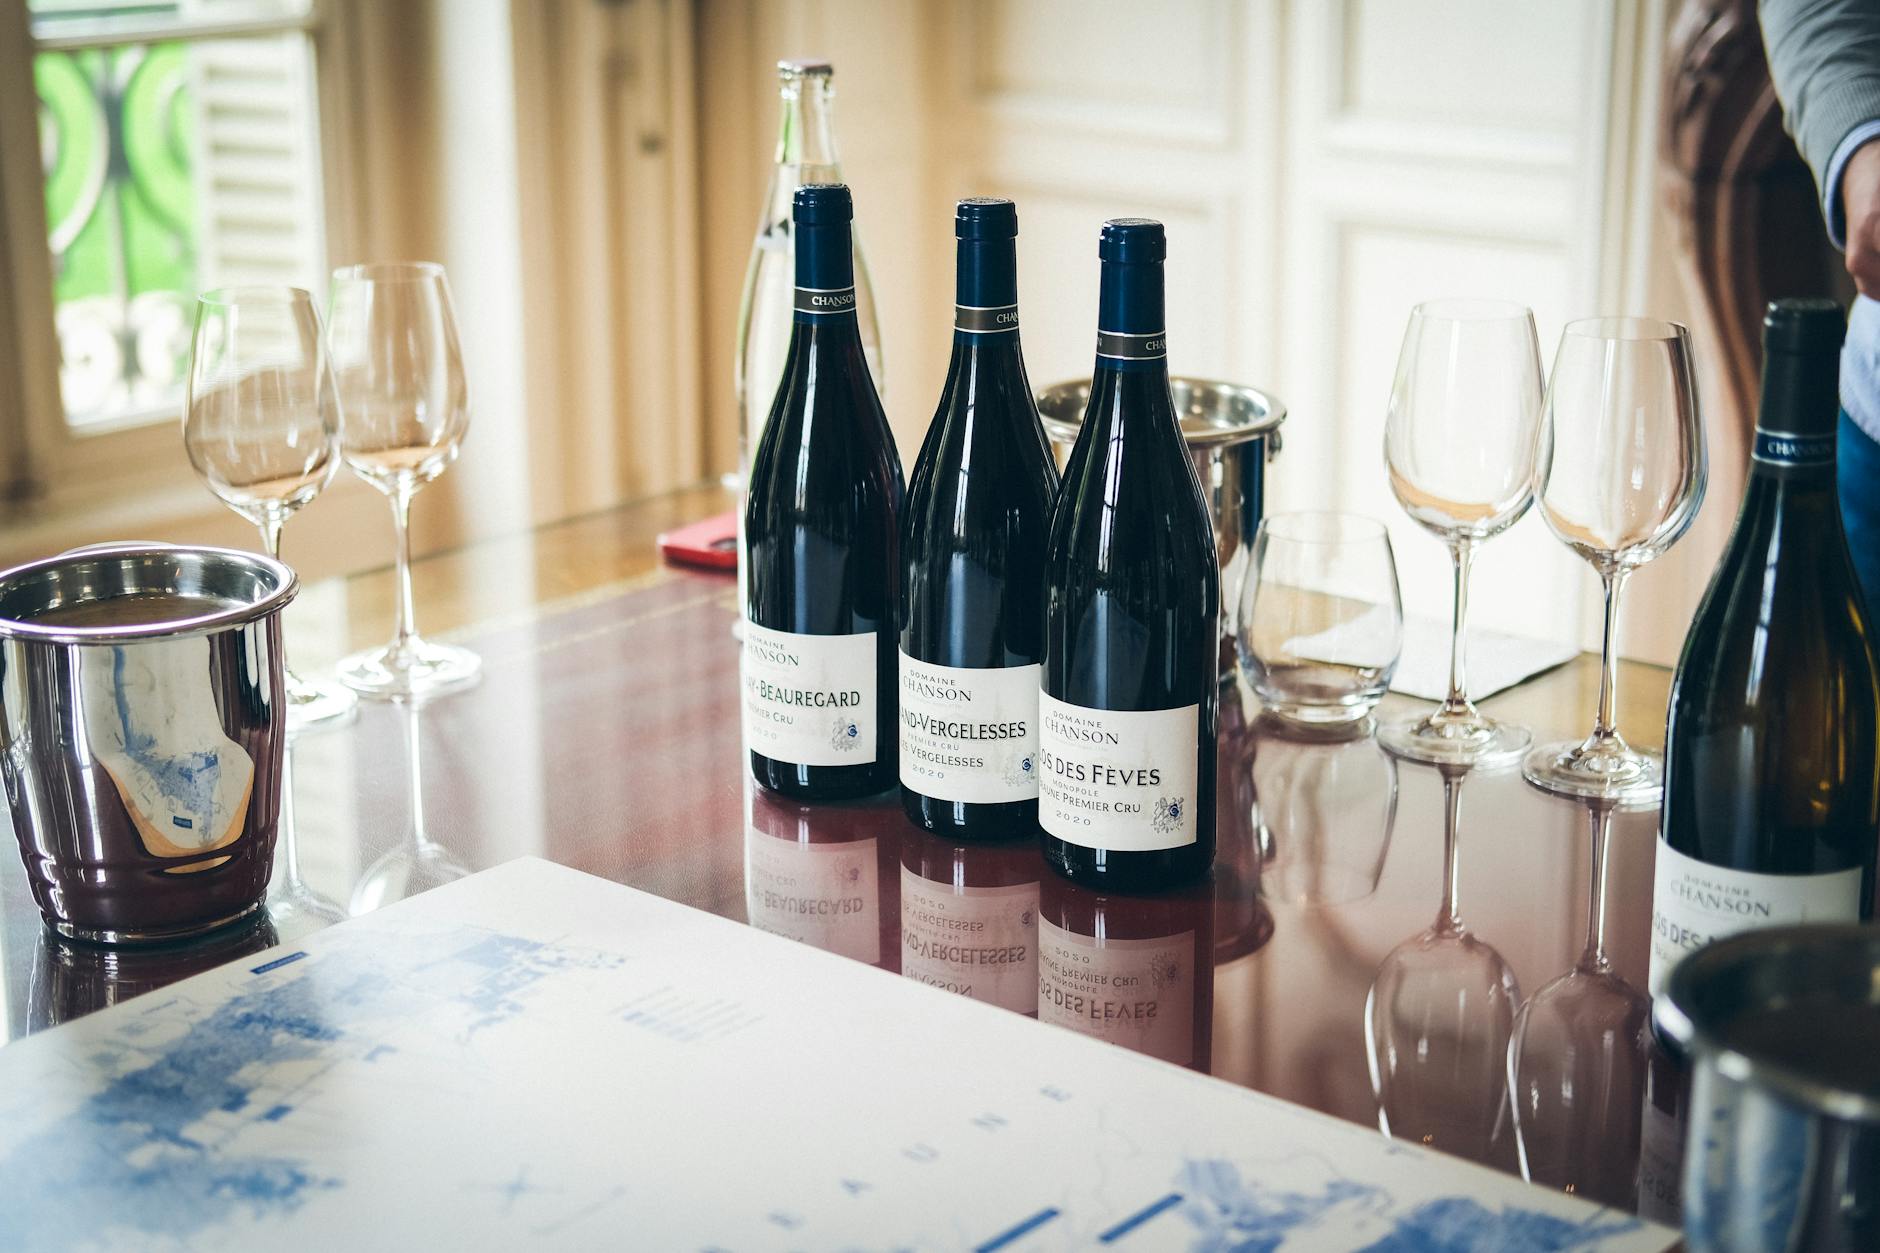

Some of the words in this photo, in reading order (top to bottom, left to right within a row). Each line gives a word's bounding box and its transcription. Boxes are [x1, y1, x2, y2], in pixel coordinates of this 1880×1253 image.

[910, 669, 956, 686] DOMAINE
[903, 675, 972, 702] CHANSON
[773, 712, 799, 725] CRU
[1053, 710, 1102, 729] DOMAINE
[1045, 716, 1119, 745] CHANSON
[910, 744, 984, 768] VERGELESSES
[941, 742, 960, 751] CRU
[912, 763, 944, 779] 2020
[1056, 757, 1085, 781] DES
[1092, 764, 1161, 786] FÈVES
[1052, 778, 1099, 798] MONOPOLE
[1063, 792, 1109, 812] PREMIER
[1114, 802, 1141, 813] CRU
[1056, 810, 1091, 826] 2020
[1670, 879, 1771, 918] CHANSON
